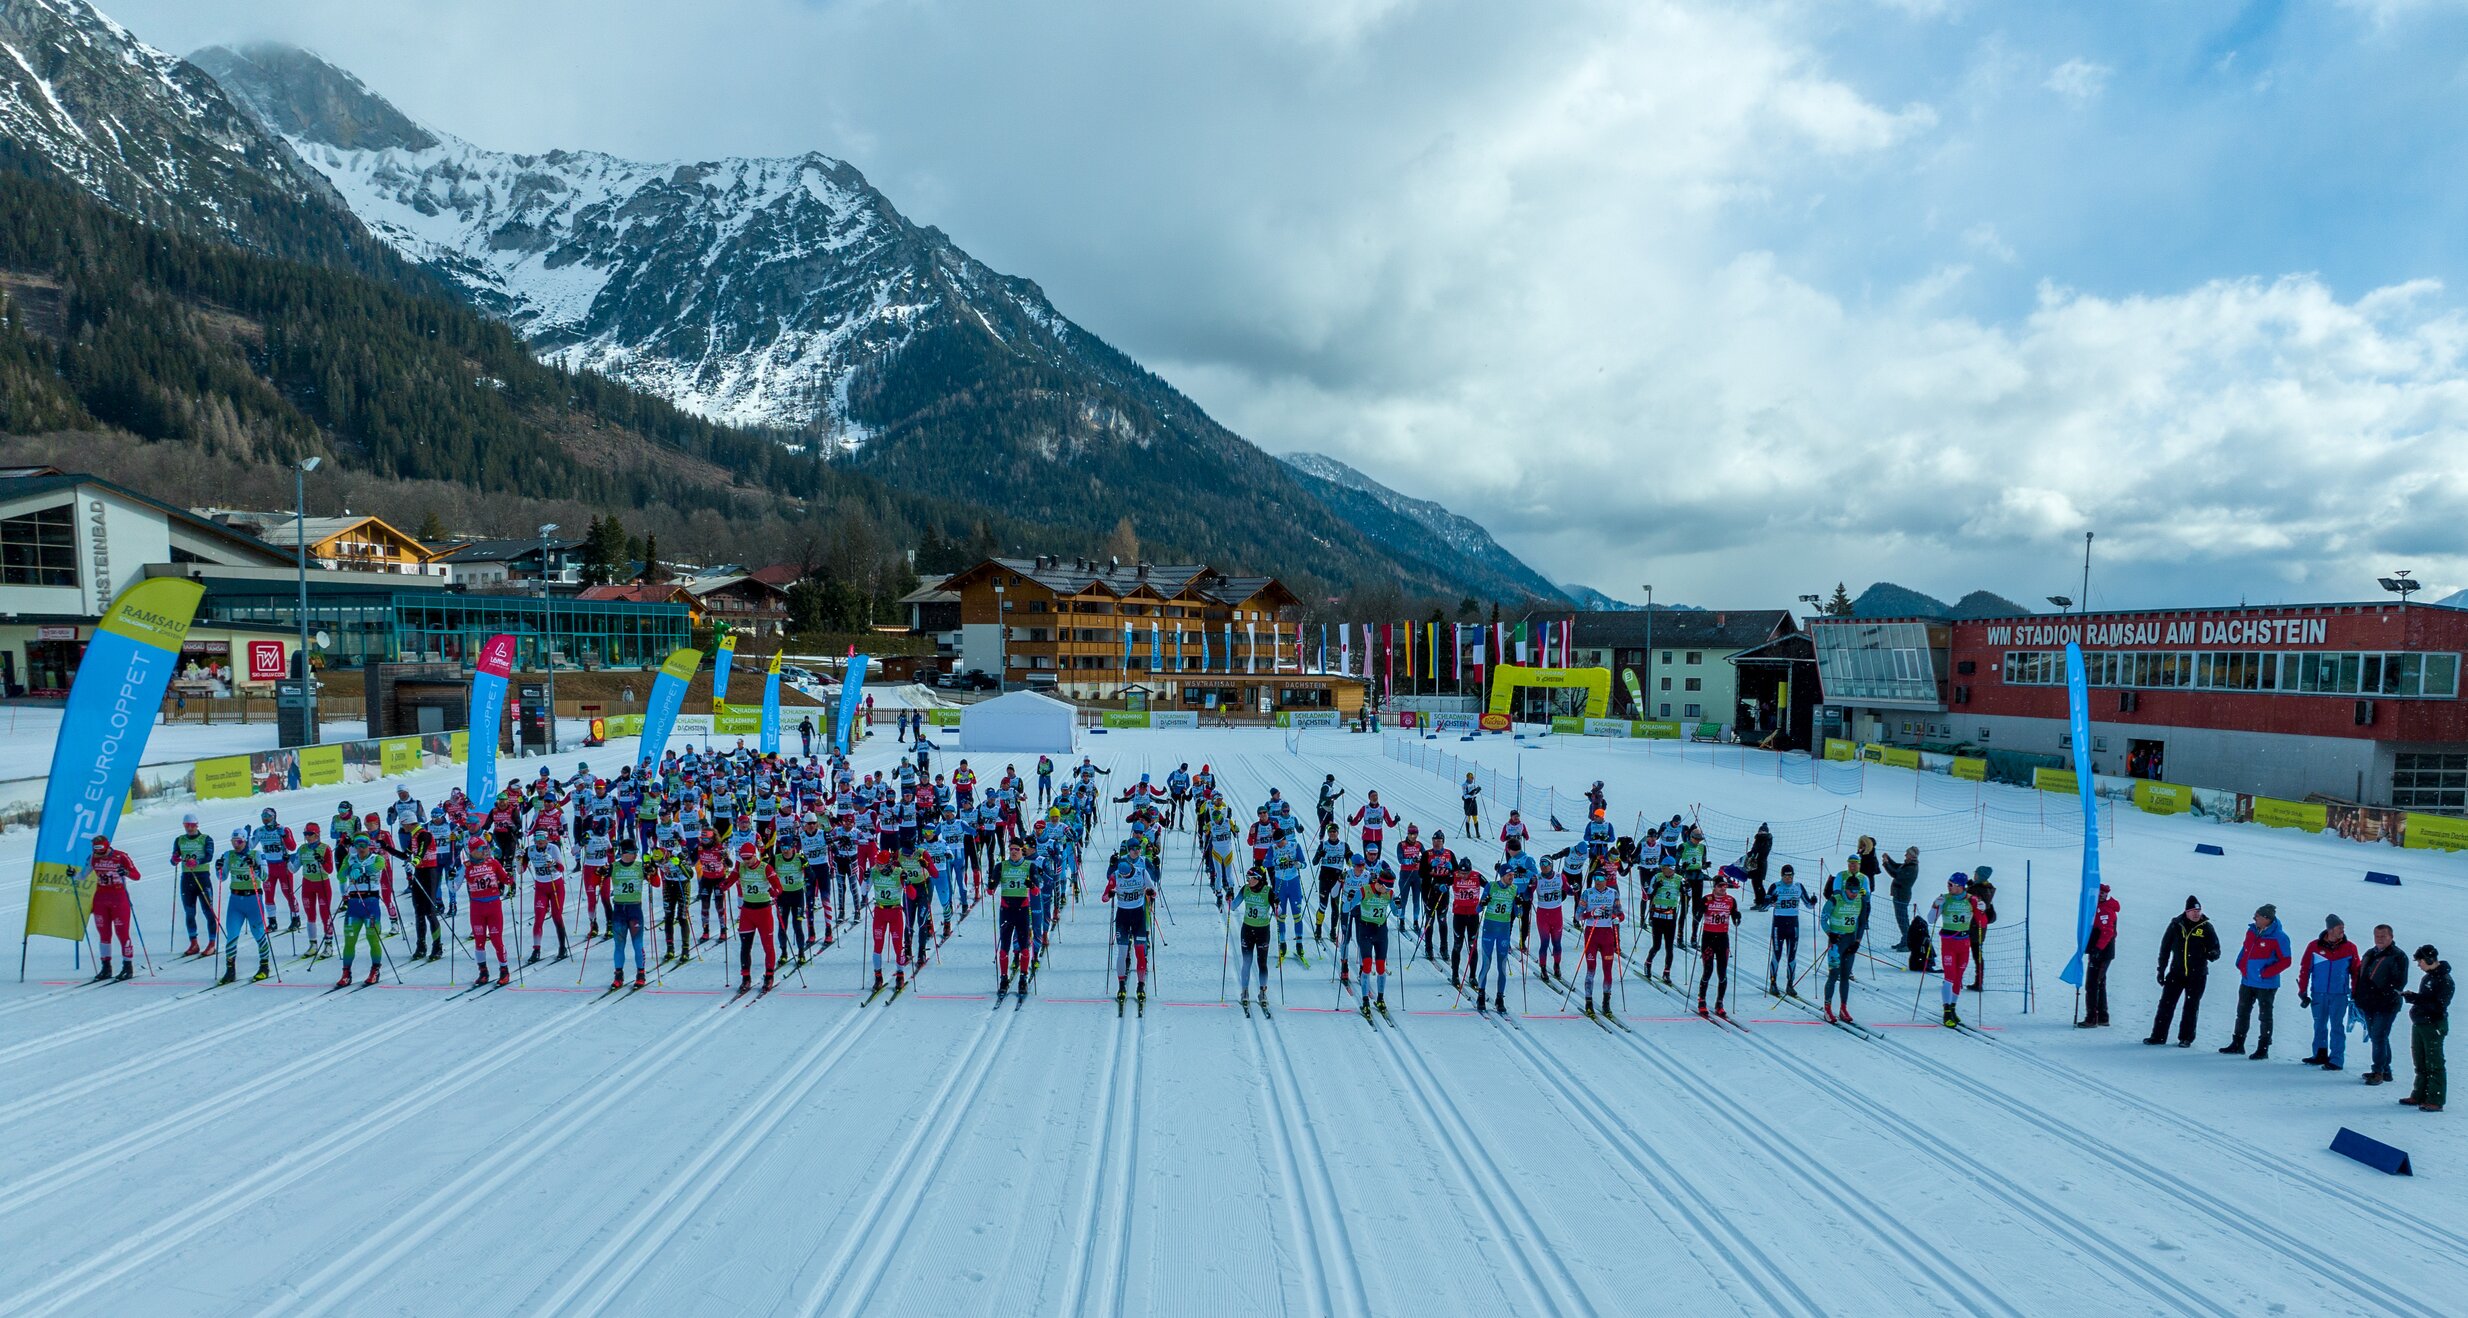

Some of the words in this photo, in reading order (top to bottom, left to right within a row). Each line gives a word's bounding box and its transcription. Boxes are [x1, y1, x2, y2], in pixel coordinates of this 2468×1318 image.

[121, 605, 187, 632] RAMSAU
[1987, 626, 2011, 646] WM
[2015, 624, 2082, 646] STADION
[2086, 622, 2160, 646] RAMSAU
[2165, 621, 2195, 645] AM
[2201, 619, 2327, 645] DACHSTEIN
[653, 681, 679, 749] EUROLOPPET
[1434, 713, 1473, 721] SCHLADMING
[86, 650, 151, 801] EUROLOPPET
[1298, 719, 1330, 727] DACHSTEIN
[1691, 857, 1697, 865] 9
[476, 877, 491, 889] 182
[784, 875, 794, 885] 15
[880, 890, 891, 899] 42
[1665, 891, 1671, 899] 2
[1372, 908, 1384, 918] 27
[1844, 916, 1856, 926] 26
[1952, 914, 1965, 924] 34
